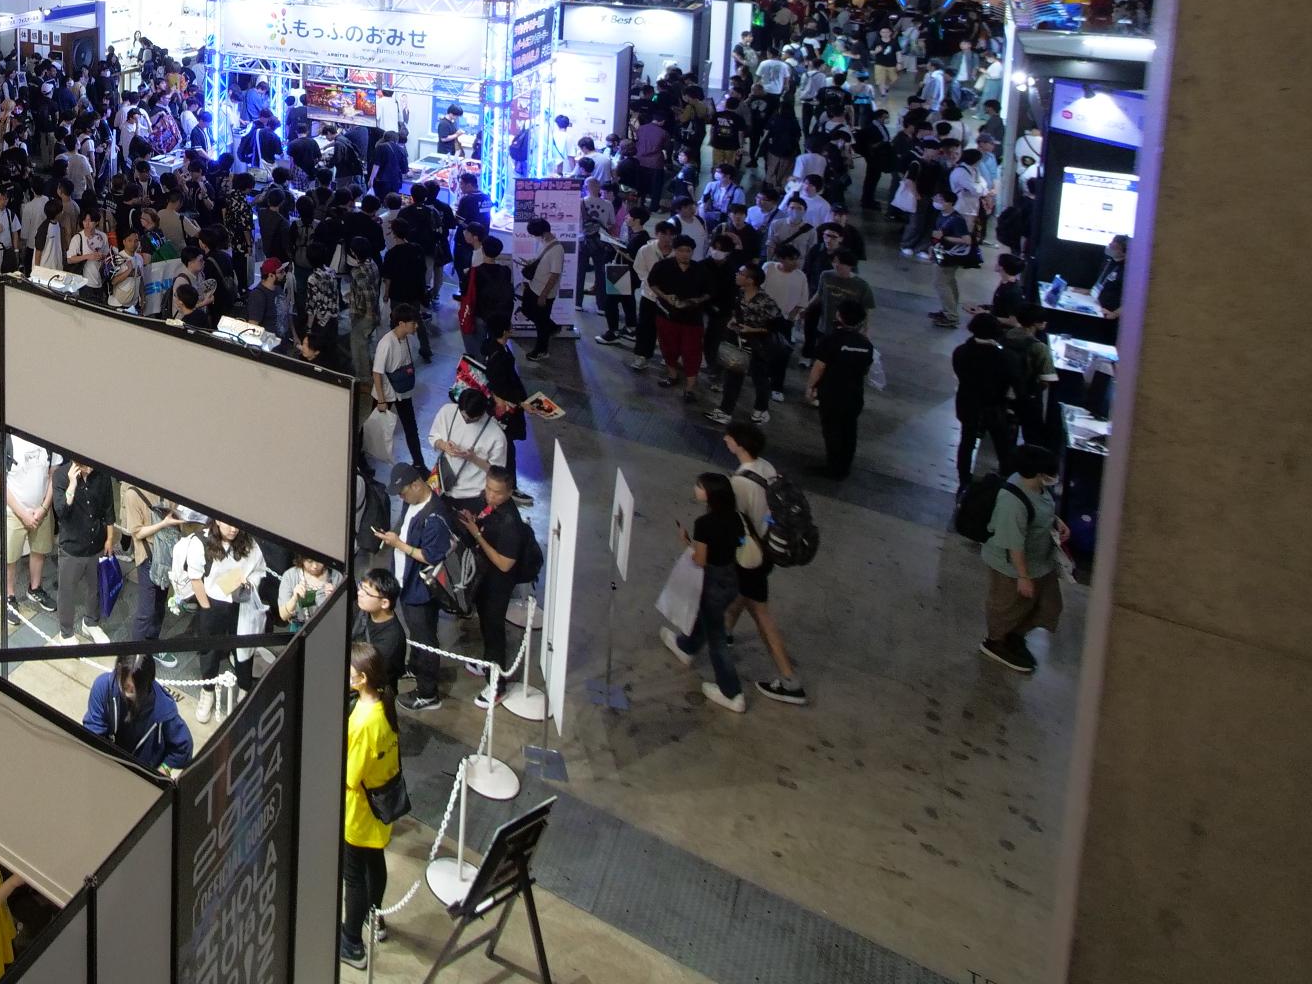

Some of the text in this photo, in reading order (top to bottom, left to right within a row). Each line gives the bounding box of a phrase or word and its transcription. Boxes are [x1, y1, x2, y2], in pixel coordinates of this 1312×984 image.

[193, 741, 283, 887] 2024
[194, 691, 285, 824] TGS
[200, 844, 240, 910] OFFICIAL
[245, 796, 276, 854] GOODS
[221, 839, 277, 940] HOLA
